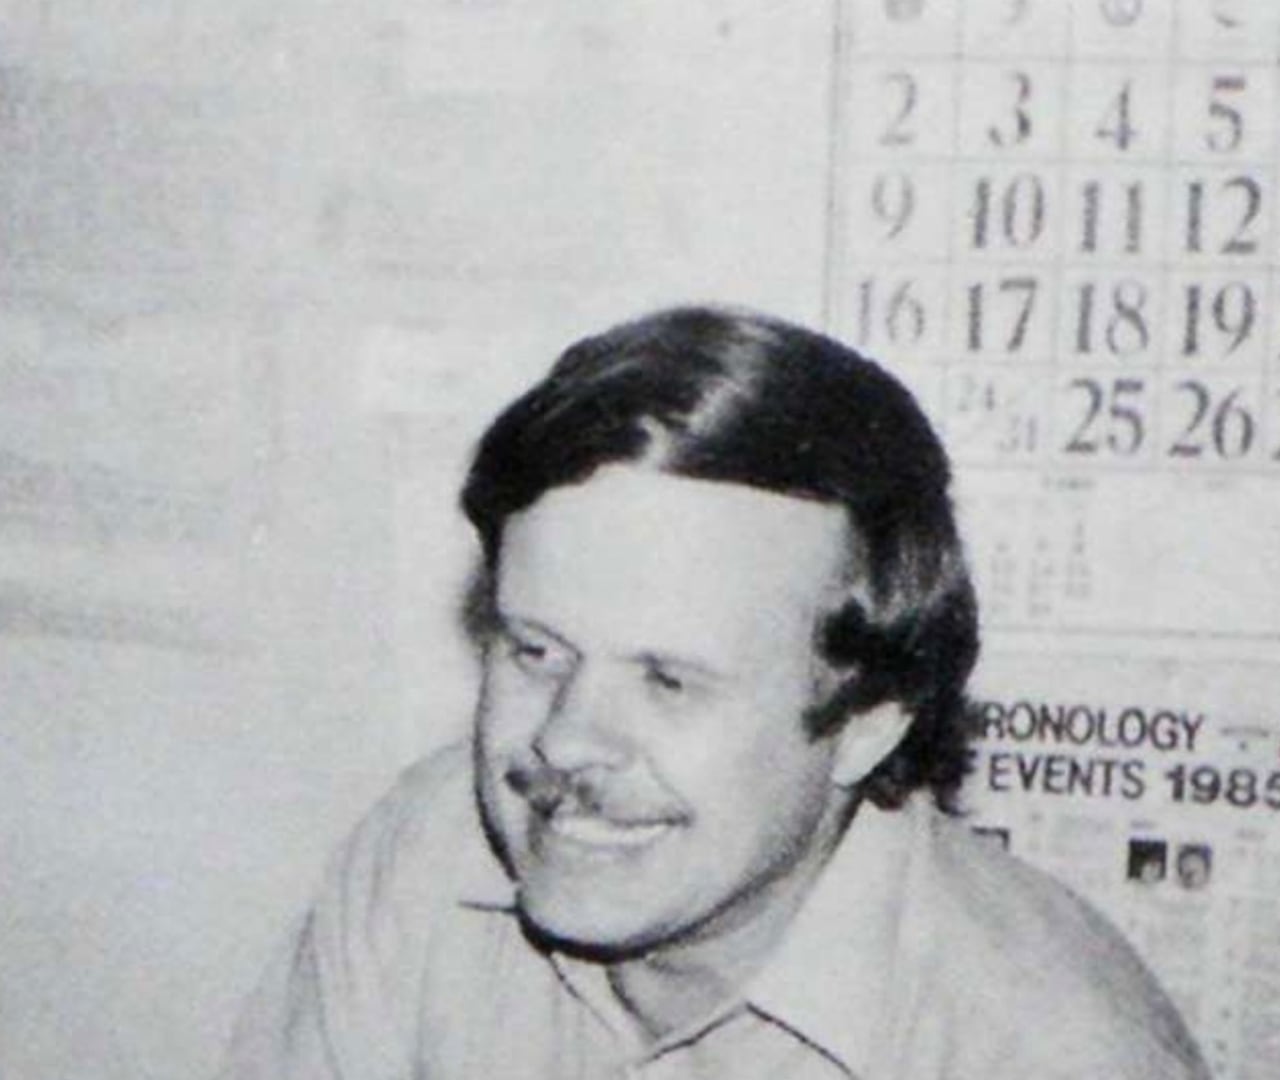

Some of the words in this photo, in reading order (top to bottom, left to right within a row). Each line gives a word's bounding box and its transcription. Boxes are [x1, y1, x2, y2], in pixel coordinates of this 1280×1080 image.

[880, 72, 918, 146] 2
[988, 73, 1032, 146] 3
[1094, 80, 1136, 151] 4
[1208, 76, 1246, 150] 5
[871, 176, 915, 240] 9
[972, 177, 1045, 249] 10
[1080, 181, 1142, 254] 11
[1186, 176, 1262, 255] 12
[857, 278, 926, 346] 16
[968, 277, 1038, 352] 17
[1076, 283, 1149, 354] 18
[1182, 285, 1256, 357] 19
[1064, 378, 1145, 454] 25
[1168, 380, 1255, 458] 26
[988, 752, 1146, 800] EVENTS
